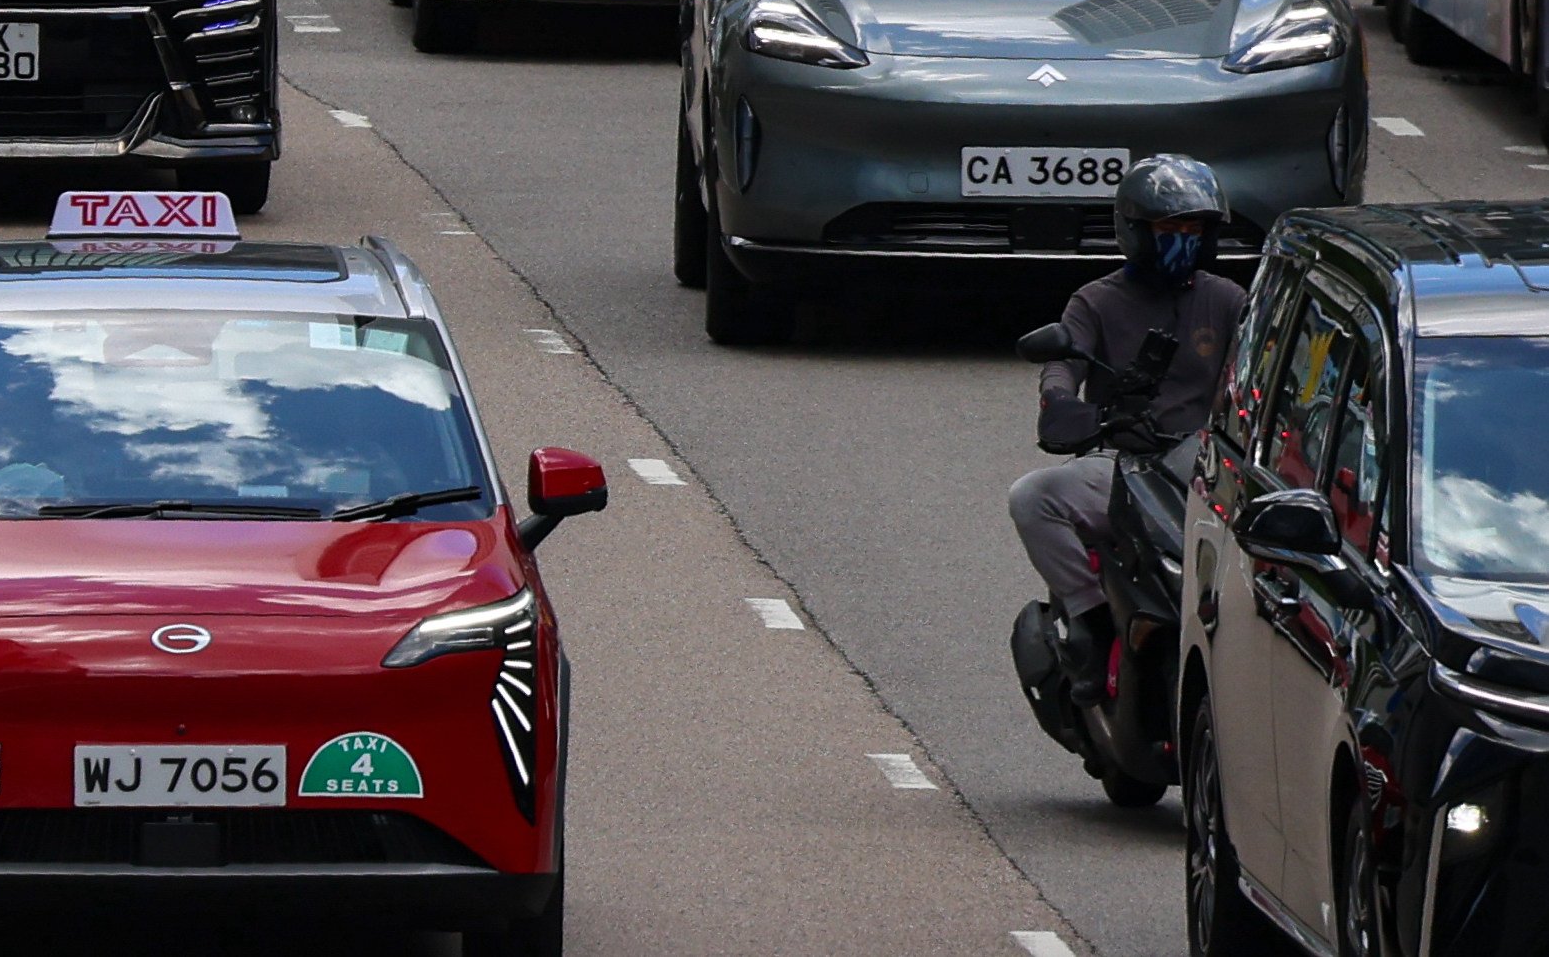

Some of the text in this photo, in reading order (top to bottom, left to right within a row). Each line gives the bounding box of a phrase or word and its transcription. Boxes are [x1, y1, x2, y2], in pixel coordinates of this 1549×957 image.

[967, 155, 1124, 186] CA 3688
[71, 195, 216, 227] TAXI
[338, 737, 387, 753] TAXI
[84, 757, 279, 793] WJ 7056
[350, 753, 374, 777] 4
[326, 779, 399, 792] SEATS
